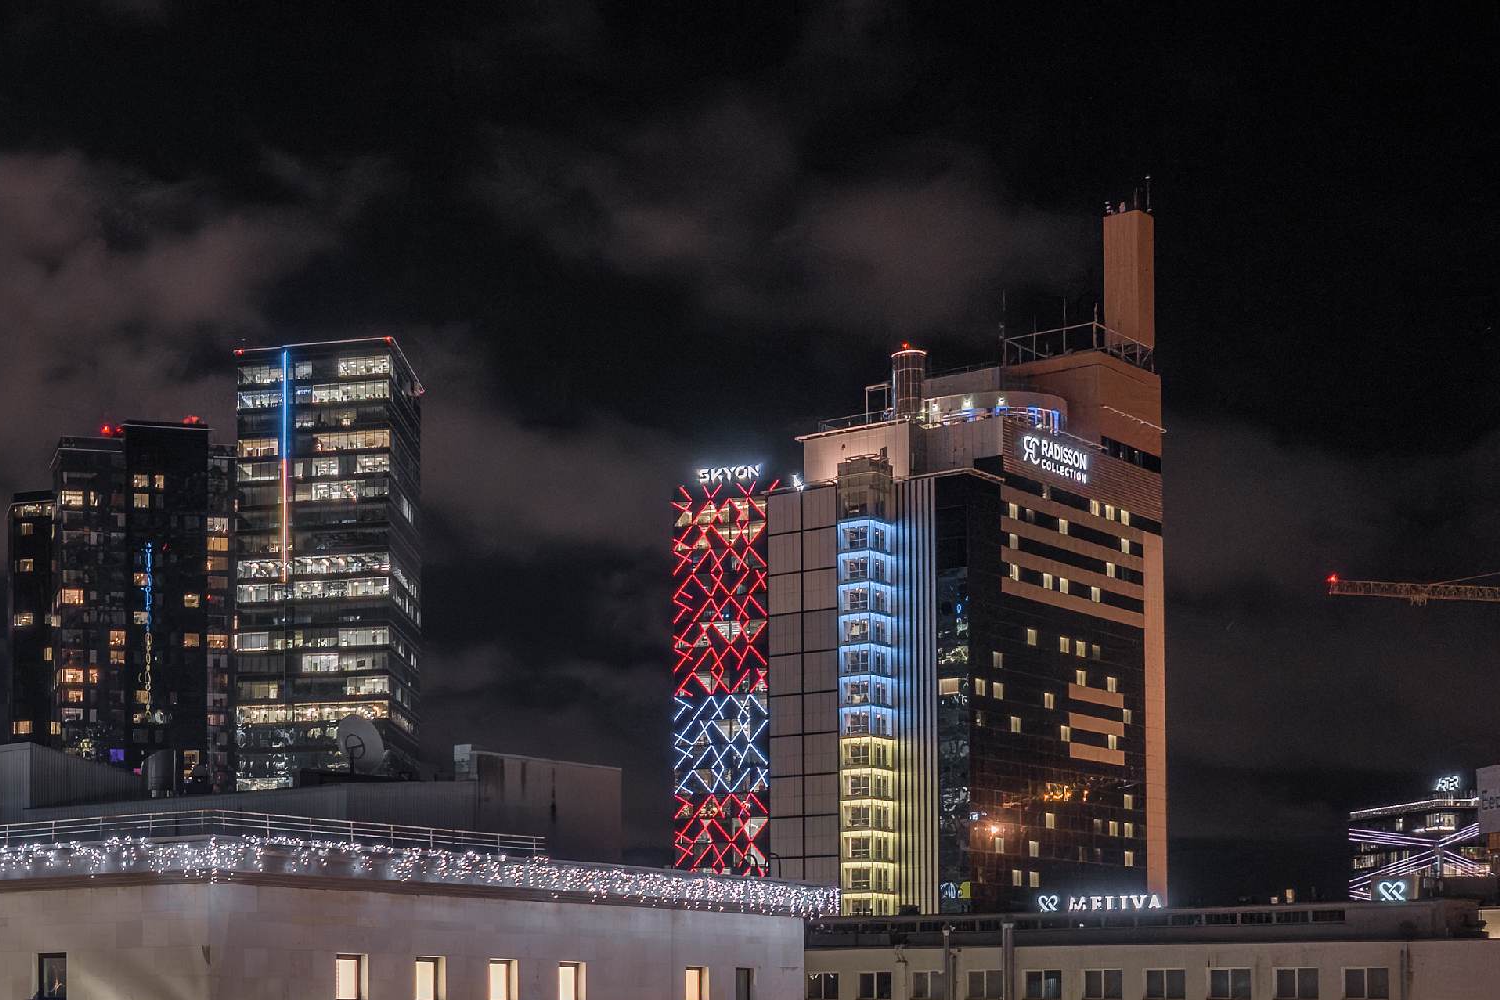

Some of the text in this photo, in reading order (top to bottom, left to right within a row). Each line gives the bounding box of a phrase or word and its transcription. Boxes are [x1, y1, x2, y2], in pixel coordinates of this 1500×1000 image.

[1041, 440, 1087, 470] RADISSON
[699, 463, 761, 484] SKYON
[1041, 459, 1087, 484] COLLECTION
